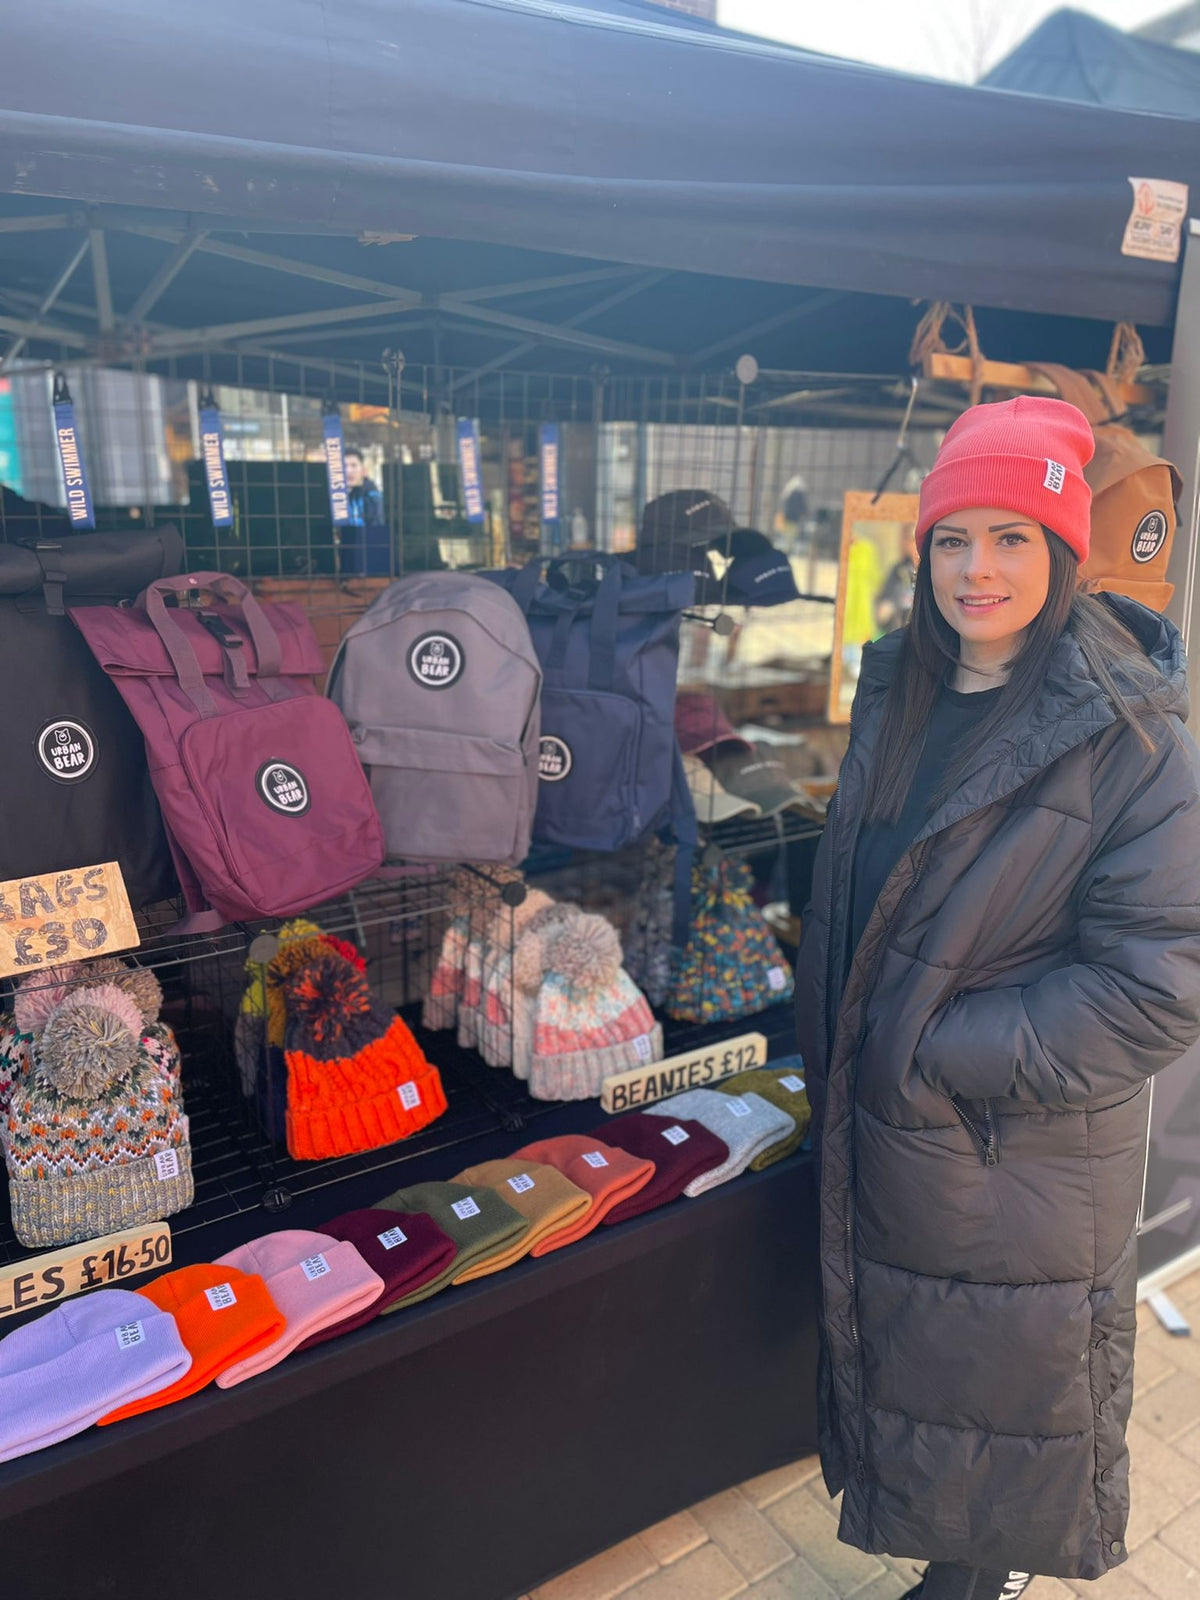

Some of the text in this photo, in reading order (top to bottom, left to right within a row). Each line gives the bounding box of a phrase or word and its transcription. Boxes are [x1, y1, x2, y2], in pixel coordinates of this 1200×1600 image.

[58, 428, 88, 520] WILD SWIMMER
[203, 433, 230, 519] WILD SWIMMER
[325, 437, 348, 519] WILD SWIMMER
[1140, 532, 1158, 541] URBAN
[1136, 540, 1156, 552] BEAR
[422, 655, 449, 664] URBAN
[421, 664, 450, 676] BEAR
[50, 742, 82, 757] URBAN
[53, 753, 85, 770] BEAR
[273, 780, 298, 794] URBAN
[278, 789, 304, 805] BEAR
[612, 1044, 758, 1111] BEANIES £12
[164, 1151, 175, 1178] BEAR
